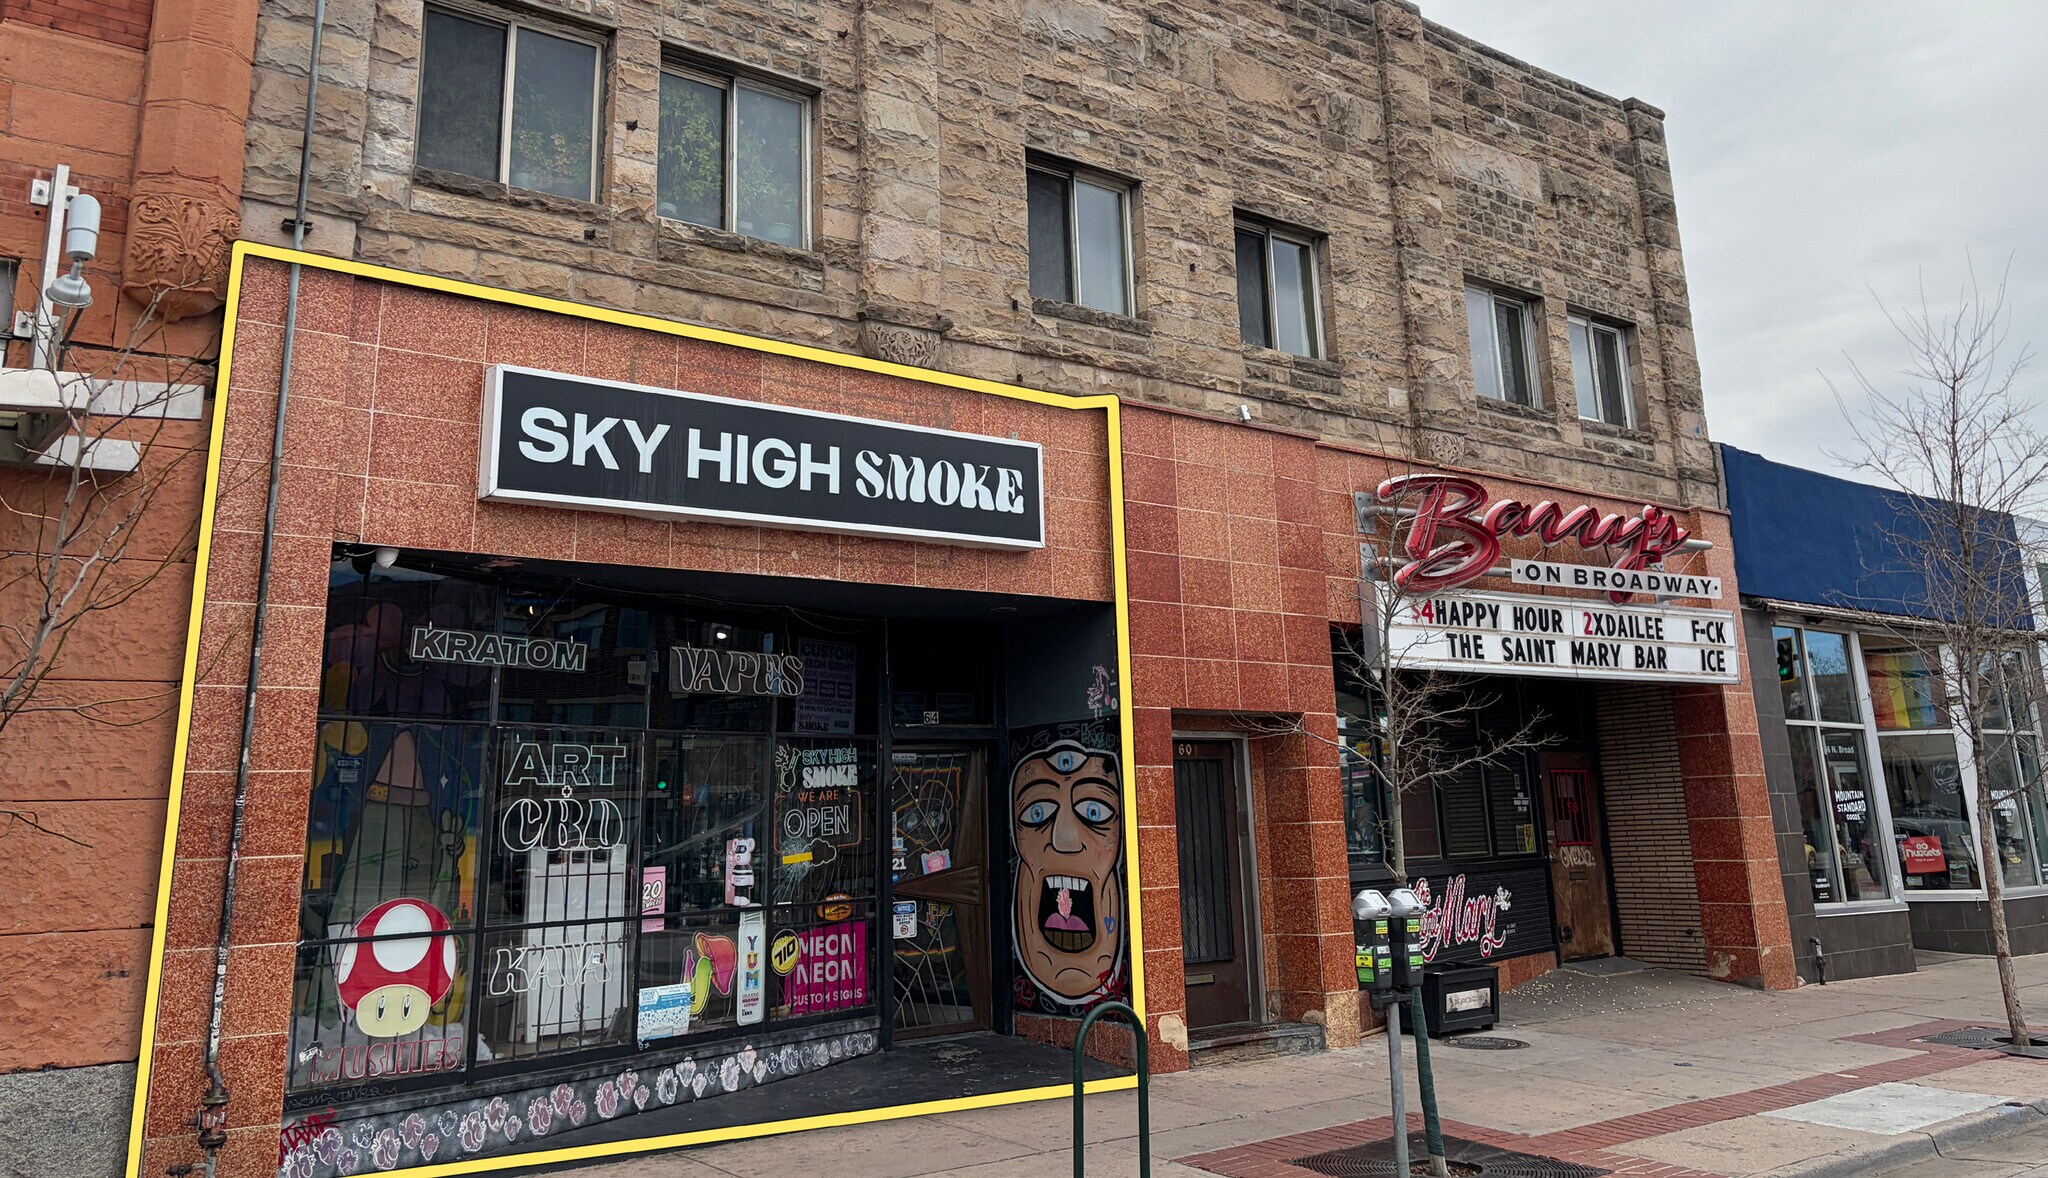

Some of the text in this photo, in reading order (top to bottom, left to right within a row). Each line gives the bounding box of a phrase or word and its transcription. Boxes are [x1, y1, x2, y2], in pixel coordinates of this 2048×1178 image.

[518, 406, 1025, 514] SKY HIGH SMOKE
[1377, 473, 1692, 604] Barry's
[1525, 563, 1711, 595] ON BROADWAY
[1513, 606, 1564, 633] HOUR
[1691, 619, 1726, 643] F-CK
[411, 627, 587, 673] KRATOM
[1446, 632, 1726, 672] THE SAINT MARY BAR ICE
[672, 646, 804, 696] VAPES
[924, 713, 938, 723] 64
[505, 743, 627, 785] ART
[802, 748, 858, 765] SKY HIGH
[1178, 744, 1192, 756] 60
[802, 764, 858, 789] SMOKE
[798, 790, 839, 803] WE ARE
[1834, 790, 1864, 802] MOUNTAIN
[1836, 801, 1866, 812] STANDARD
[502, 798, 623, 852] CBD
[784, 805, 849, 838] OPEN
[892, 857, 907, 870] 21
[1440, 874, 1506, 957] Mary
[489, 942, 611, 996] KAVA
[746, 936, 759, 990] YUM
[774, 938, 795, 967] 710
[796, 958, 856, 985] NEON
[310, 1037, 461, 1085] MUSHIES
